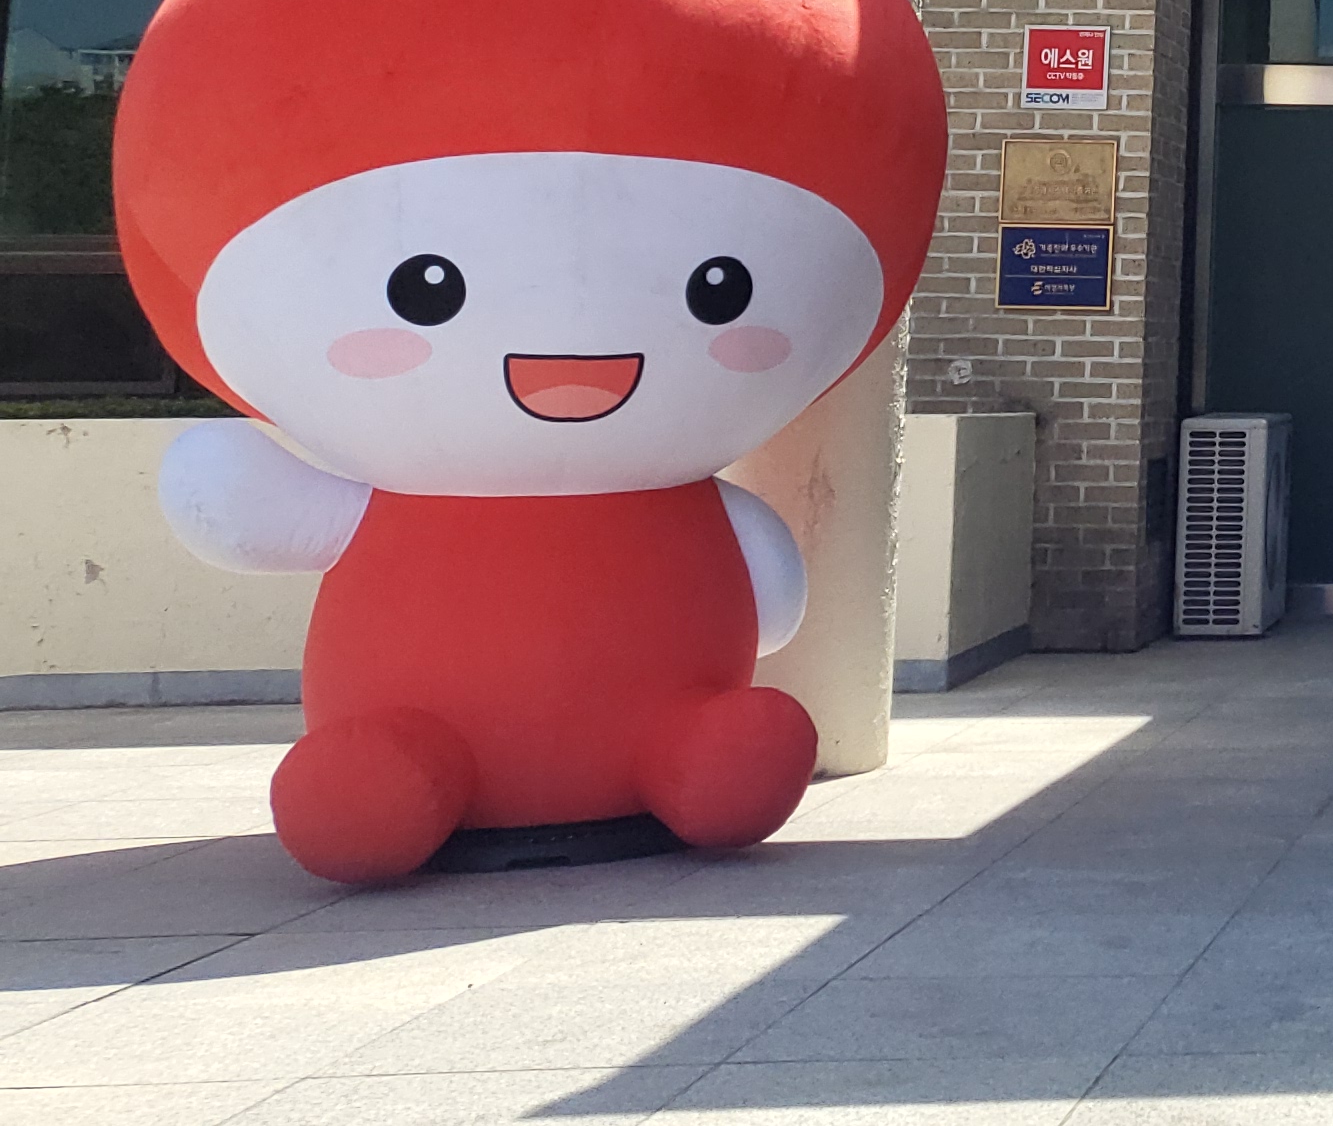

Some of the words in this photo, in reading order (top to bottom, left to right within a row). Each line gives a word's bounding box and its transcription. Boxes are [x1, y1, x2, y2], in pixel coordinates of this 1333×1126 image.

[1040, 47, 1093, 70] 에스원
[1046, 72, 1066, 80] CCTV
[1026, 92, 1070, 105] SECOM
